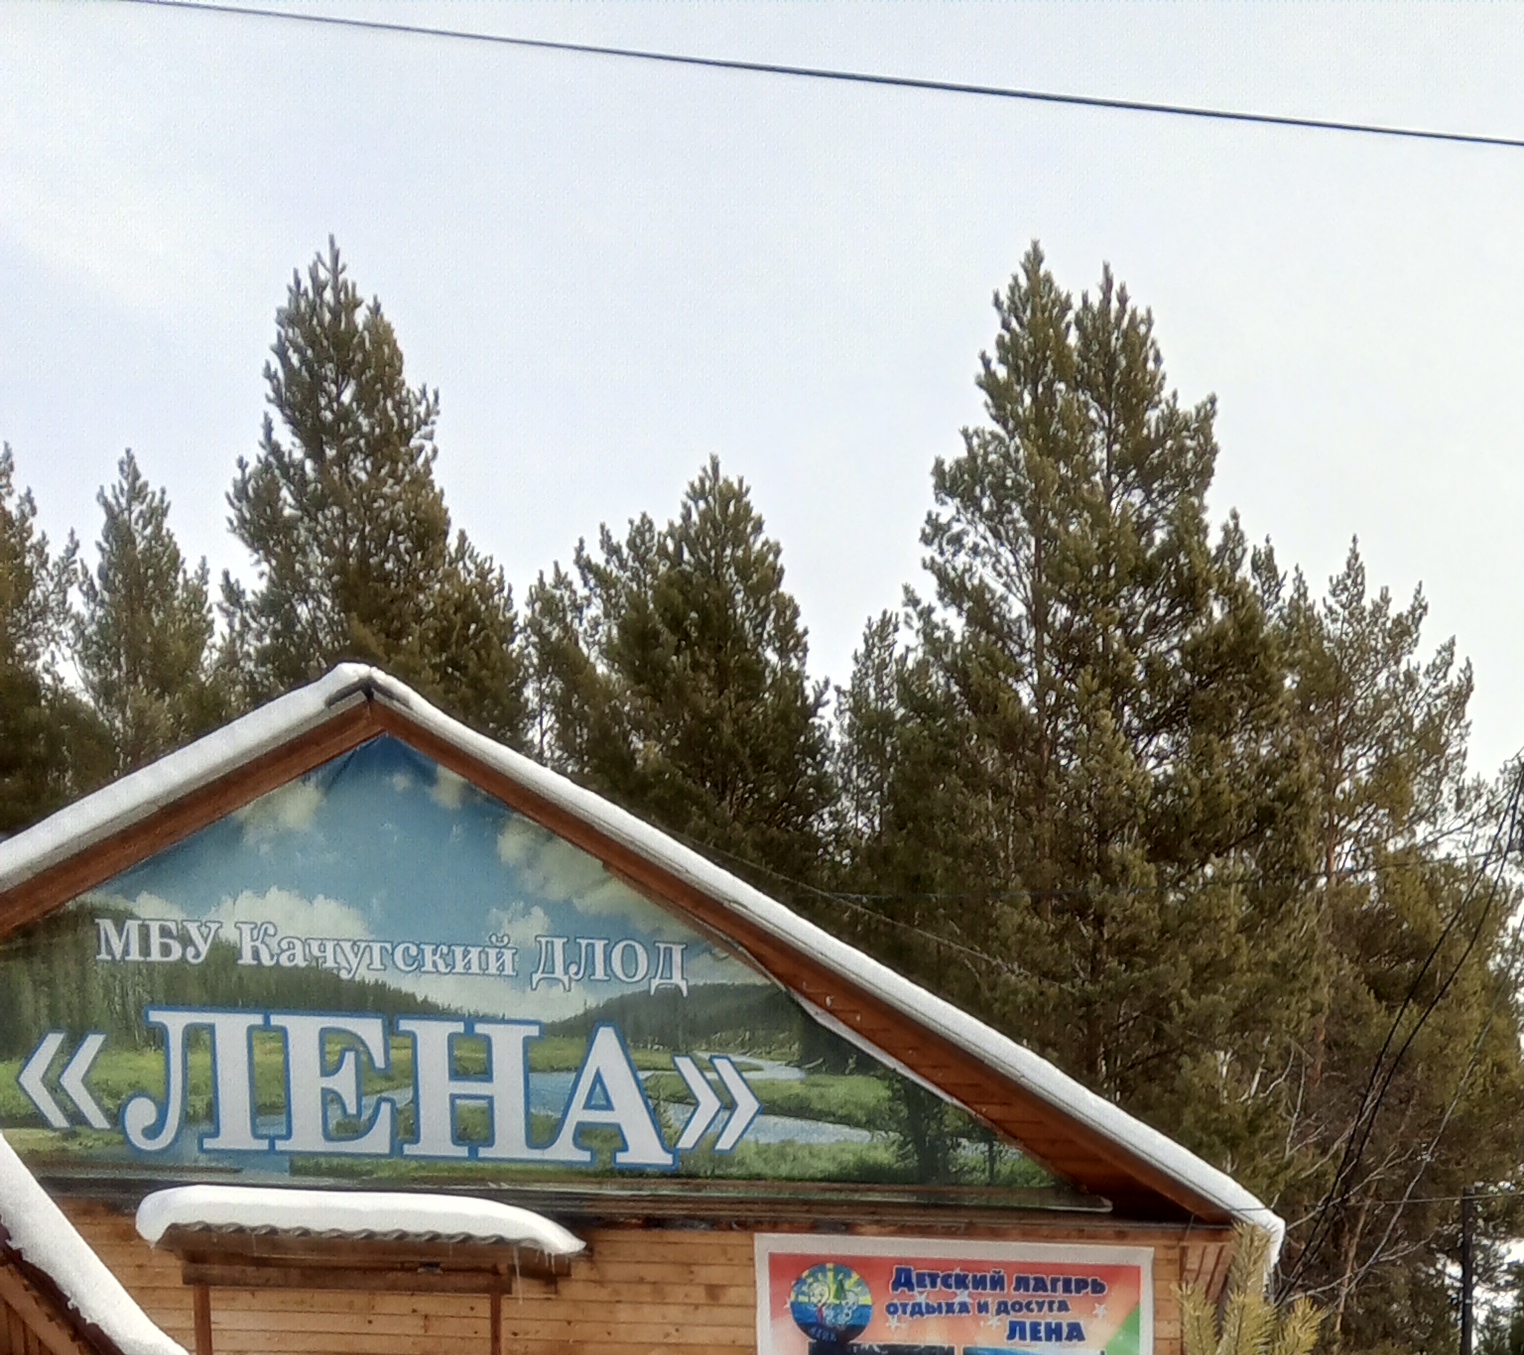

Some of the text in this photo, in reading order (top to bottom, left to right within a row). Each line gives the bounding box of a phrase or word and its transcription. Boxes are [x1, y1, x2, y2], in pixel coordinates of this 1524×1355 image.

[95, 918, 689, 998] МБУ Качугский ДЛОД
[1006, 1320, 1086, 1342] ЛЕНА
